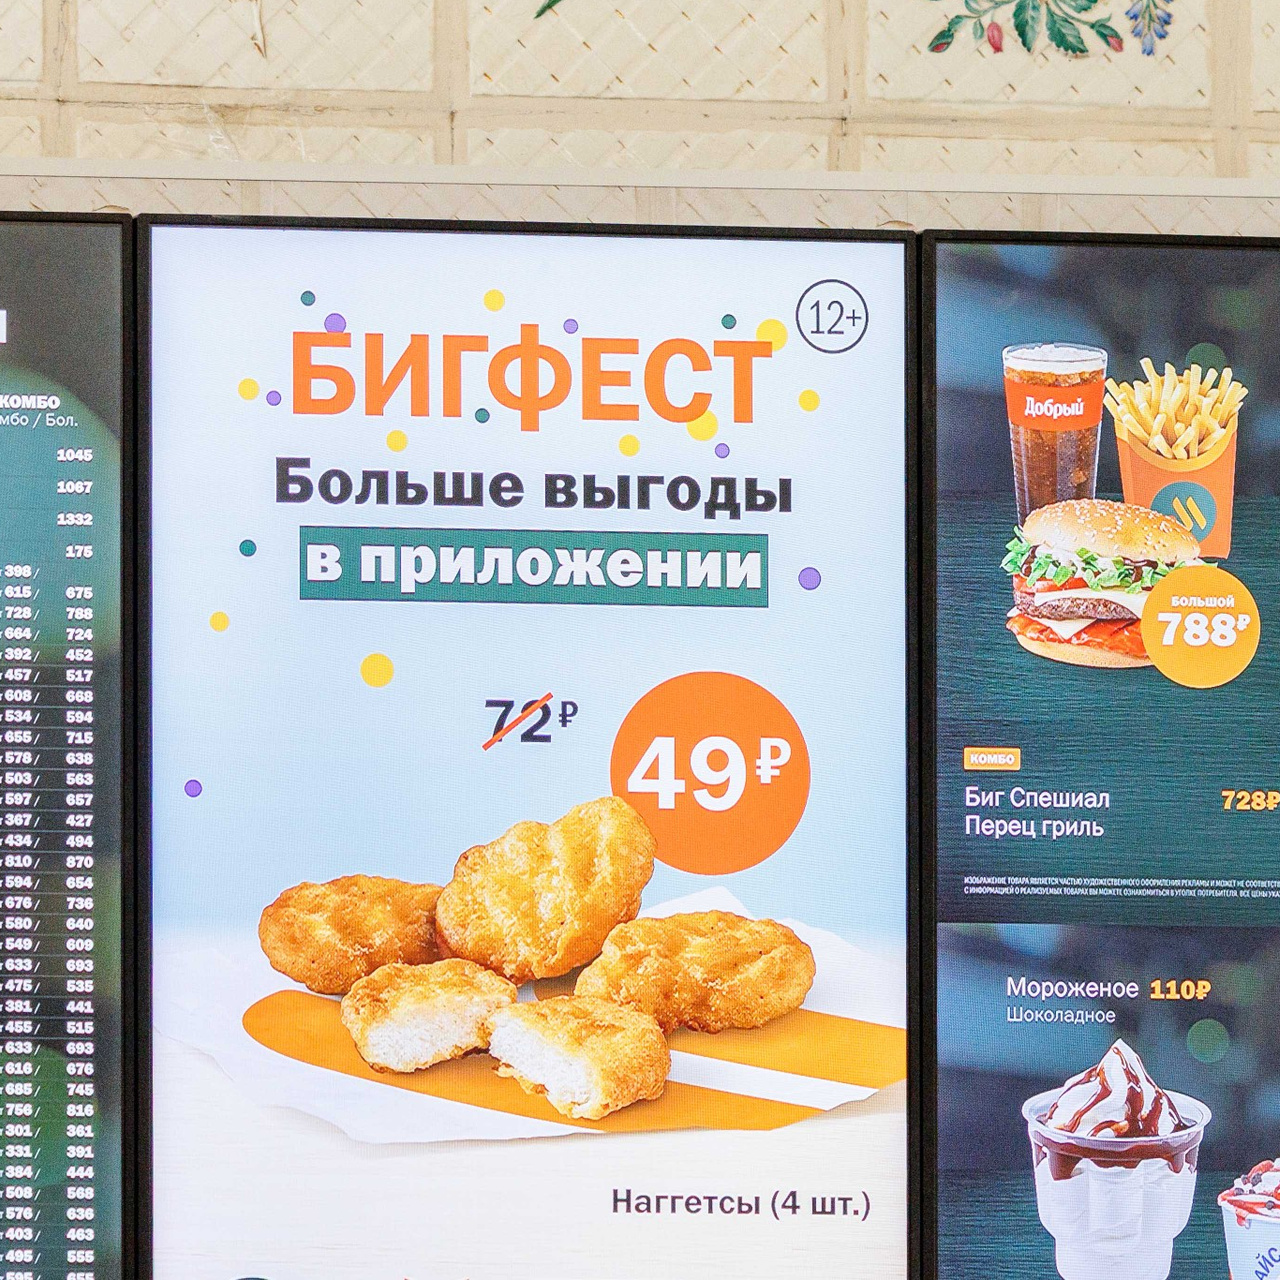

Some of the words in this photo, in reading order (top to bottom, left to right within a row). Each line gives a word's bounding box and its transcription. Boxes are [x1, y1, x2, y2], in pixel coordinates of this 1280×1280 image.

[810, 300, 862, 335] 12+
[292, 323, 772, 432] БИГФЕСТ
[0, 395, 61, 410] КОМБО
[1024, 396, 1085, 420] Добрый
[0, 412, 29, 426] мбо
[46, 413, 79, 426] Бол.
[56, 448, 94, 462] 1045
[57, 480, 93, 494] 1067
[275, 456, 524, 508] Больше
[544, 474, 792, 520] выгоды
[57, 513, 93, 526] 1332
[65, 545, 94, 558] 175
[306, 543, 342, 582] в
[361, 544, 762, 593] приложении
[65, 586, 94, 599] 675
[1171, 595, 1235, 608] БОЛЬШОЙ
[66, 607, 94, 620] 788
[66, 628, 94, 641] 724
[65, 648, 94, 661] 452
[66, 669, 94, 682] 517
[65, 690, 94, 703] 668
[66, 710, 94, 723] 594
[66, 731, 94, 744] 715
[65, 752, 94, 765] 638
[970, 753, 1015, 766] КОМБО
[66, 772, 94, 785] 563
[65, 793, 94, 806] 657
[965, 786, 1004, 808] Биг
[1010, 787, 1110, 809] Спешиал
[65, 814, 94, 827] 427
[965, 815, 1036, 839] Перец
[1042, 820, 1105, 839] гриль
[66, 835, 94, 848] 494
[66, 855, 94, 868] 870
[66, 876, 94, 889] 654
[66, 897, 94, 910] 736
[66, 918, 94, 930] 640
[66, 938, 94, 951] 609
[66, 959, 94, 972] 693
[66, 979, 94, 992] 535
[1007, 977, 1139, 1000] Мороженое
[66, 1000, 94, 1013] 441
[1007, 1006, 1116, 1024] Шоколадное
[66, 1021, 94, 1034] 515
[66, 1042, 94, 1055] 693
[66, 1062, 94, 1075] 676
[67, 1083, 95, 1096] 745
[66, 1104, 94, 1117] 816
[66, 1124, 94, 1138] 361
[66, 1145, 95, 1158] 391
[66, 1166, 95, 1179] 444
[67, 1186, 95, 1200] 568
[612, 1189, 760, 1214] Наггетсы
[771, 1190, 800, 1220] (4
[811, 1191, 871, 1221] шт.)
[66, 1207, 95, 1220] 636
[66, 1228, 95, 1241] 463
[67, 1250, 95, 1263] 555
